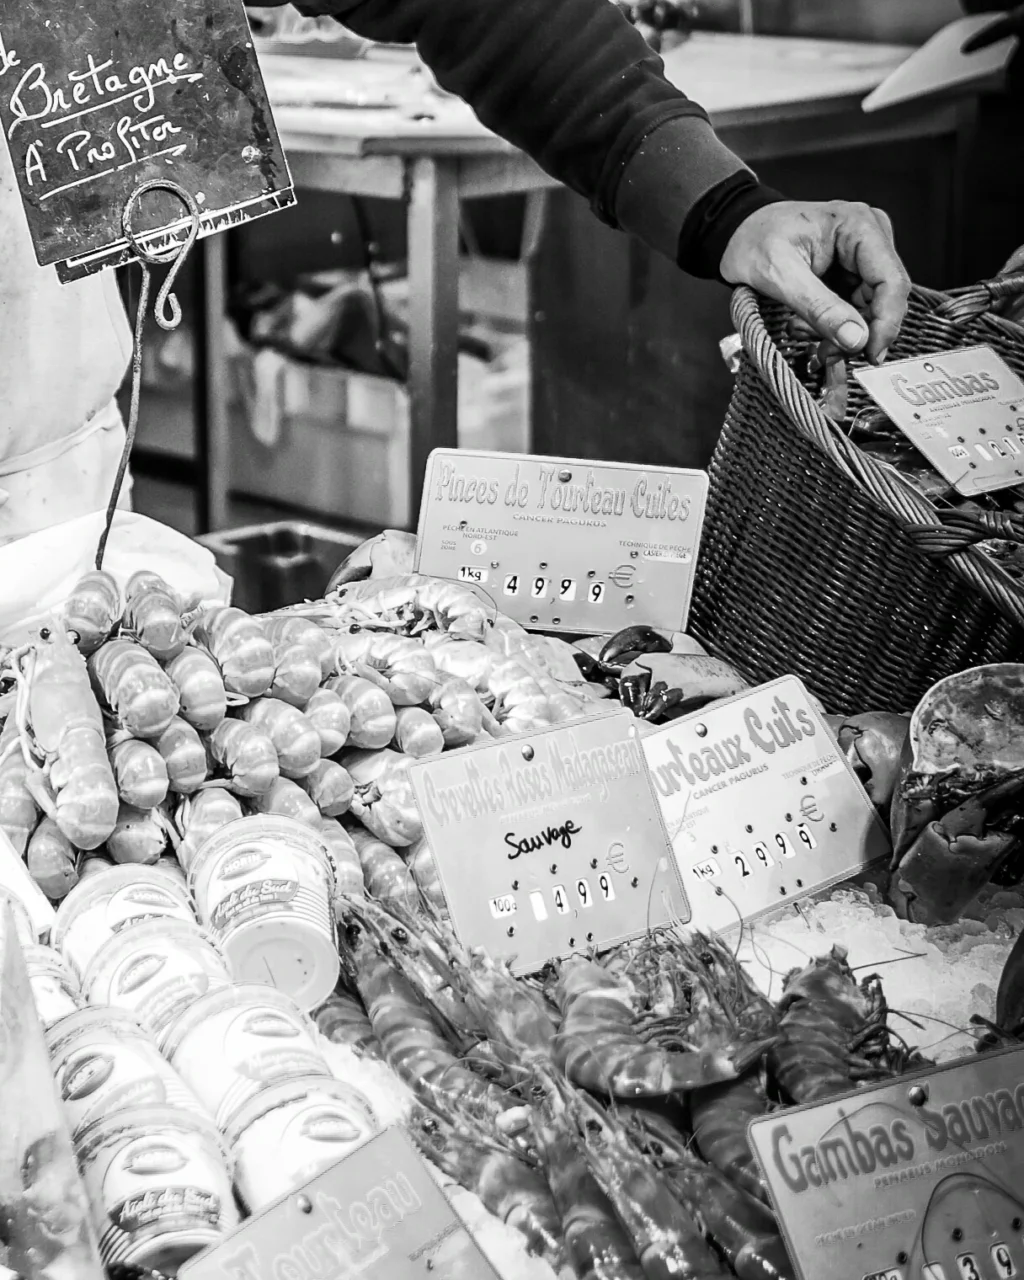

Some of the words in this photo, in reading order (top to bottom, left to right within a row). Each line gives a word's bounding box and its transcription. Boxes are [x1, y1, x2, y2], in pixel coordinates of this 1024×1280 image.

[890, 365, 1000, 407] Gambas
[434, 460, 500, 504] Pinces
[504, 465, 529, 509] de
[537, 466, 626, 517] Tourteau
[629, 474, 692, 522] Cuites
[473, 542, 482, 554] 6
[460, 566, 482, 582] 1kg
[650, 733, 753, 798] urteaux
[743, 695, 816, 754] Cuits
[422, 758, 506, 827] Crevettes
[499, 749, 554, 811] Roses
[692, 779, 728, 801] CANCER
[728, 762, 770, 788] PAGURUS
[504, 819, 583, 860] Sauvage
[255, 877, 294, 901] Sud
[692, 864, 714, 881] 1kg
[771, 1107, 915, 1195] Gambas
